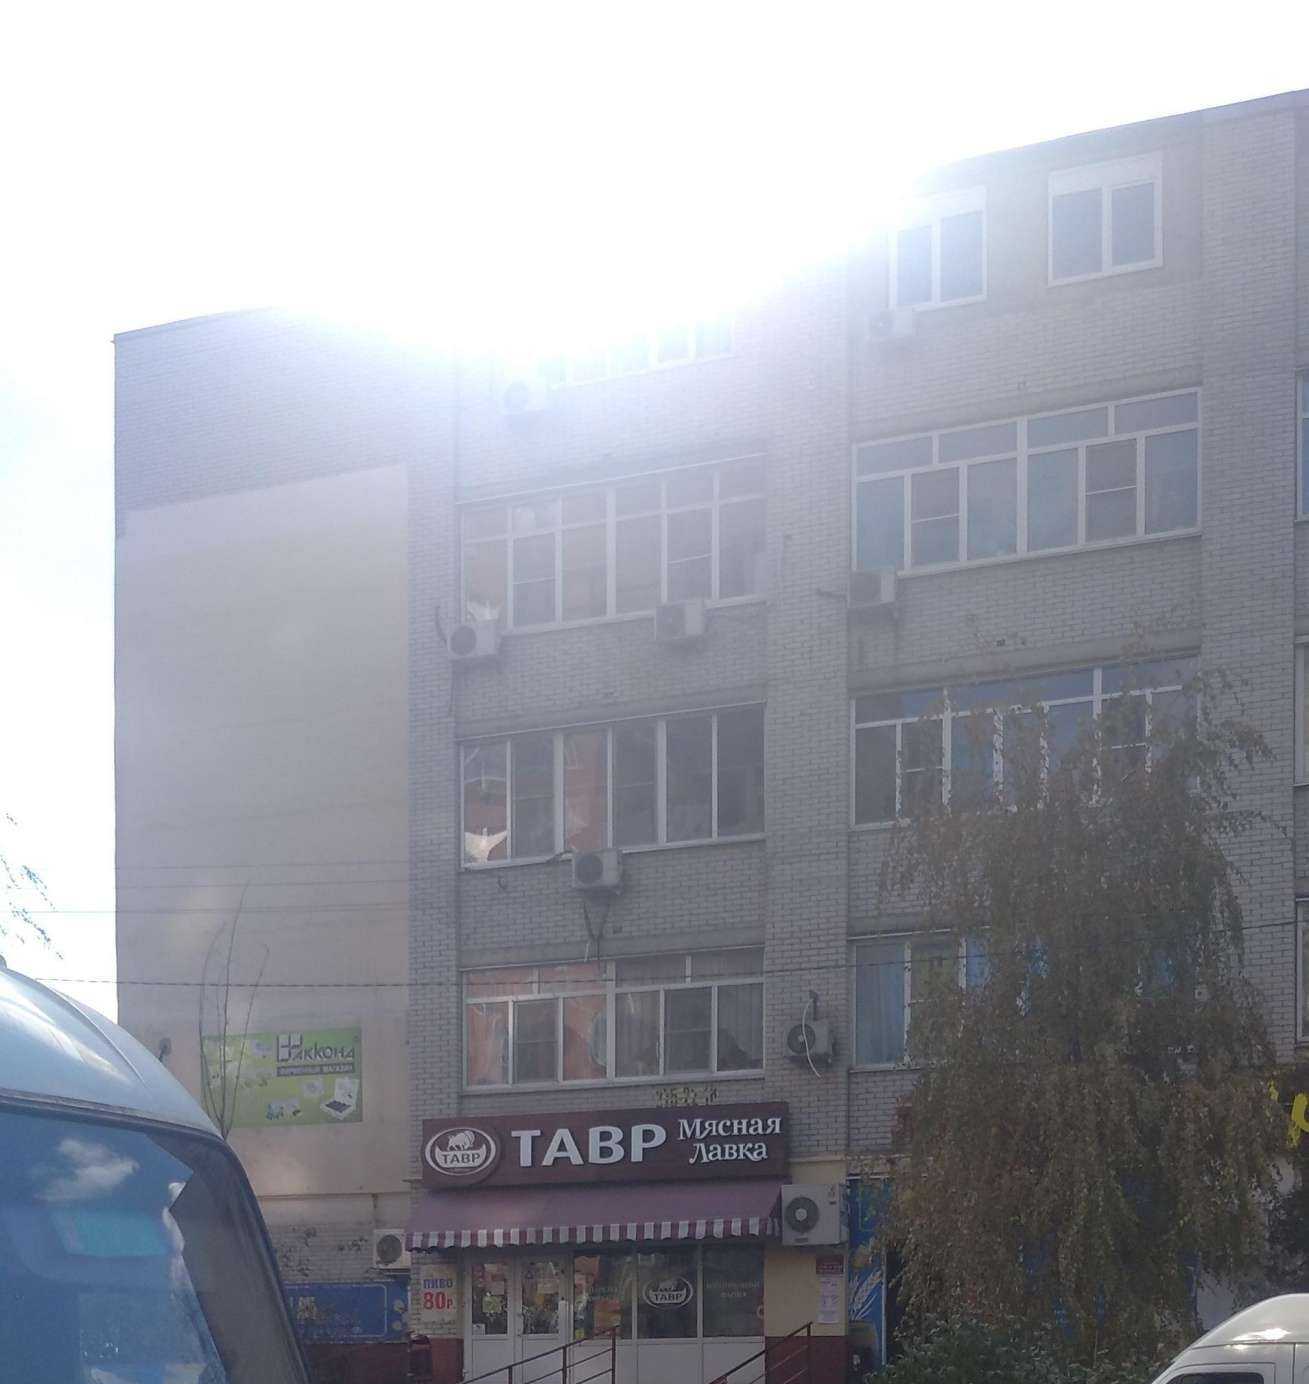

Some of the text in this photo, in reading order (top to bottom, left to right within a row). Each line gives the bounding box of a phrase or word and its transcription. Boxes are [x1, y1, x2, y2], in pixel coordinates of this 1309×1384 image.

[677, 1117, 782, 1140] Мясная
[511, 1124, 666, 1167] ТАВР
[689, 1142, 768, 1164] Лавка
[441, 1153, 480, 1164] ТАВР
[653, 1292, 683, 1302] ТАВР
